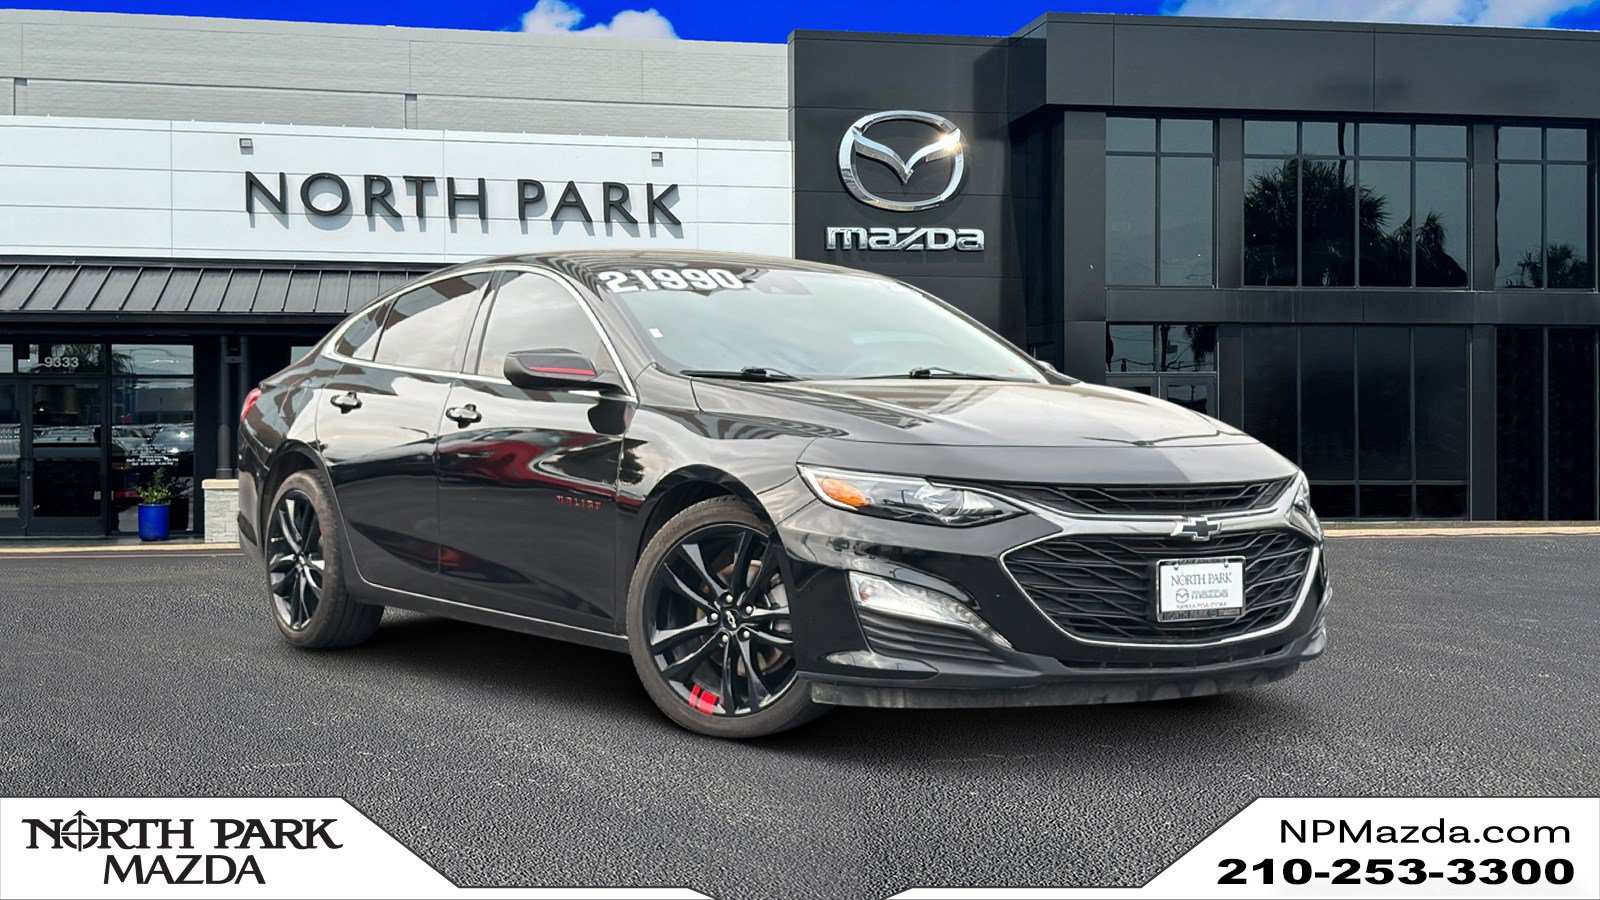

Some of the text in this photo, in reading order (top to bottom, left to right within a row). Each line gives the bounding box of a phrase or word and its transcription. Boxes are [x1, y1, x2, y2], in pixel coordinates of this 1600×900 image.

[245, 171, 682, 225] NORTH PARK
[598, 268, 746, 293] 21990
[44, 356, 79, 368] 9333
[1171, 572, 1232, 586] NORTH PARK
